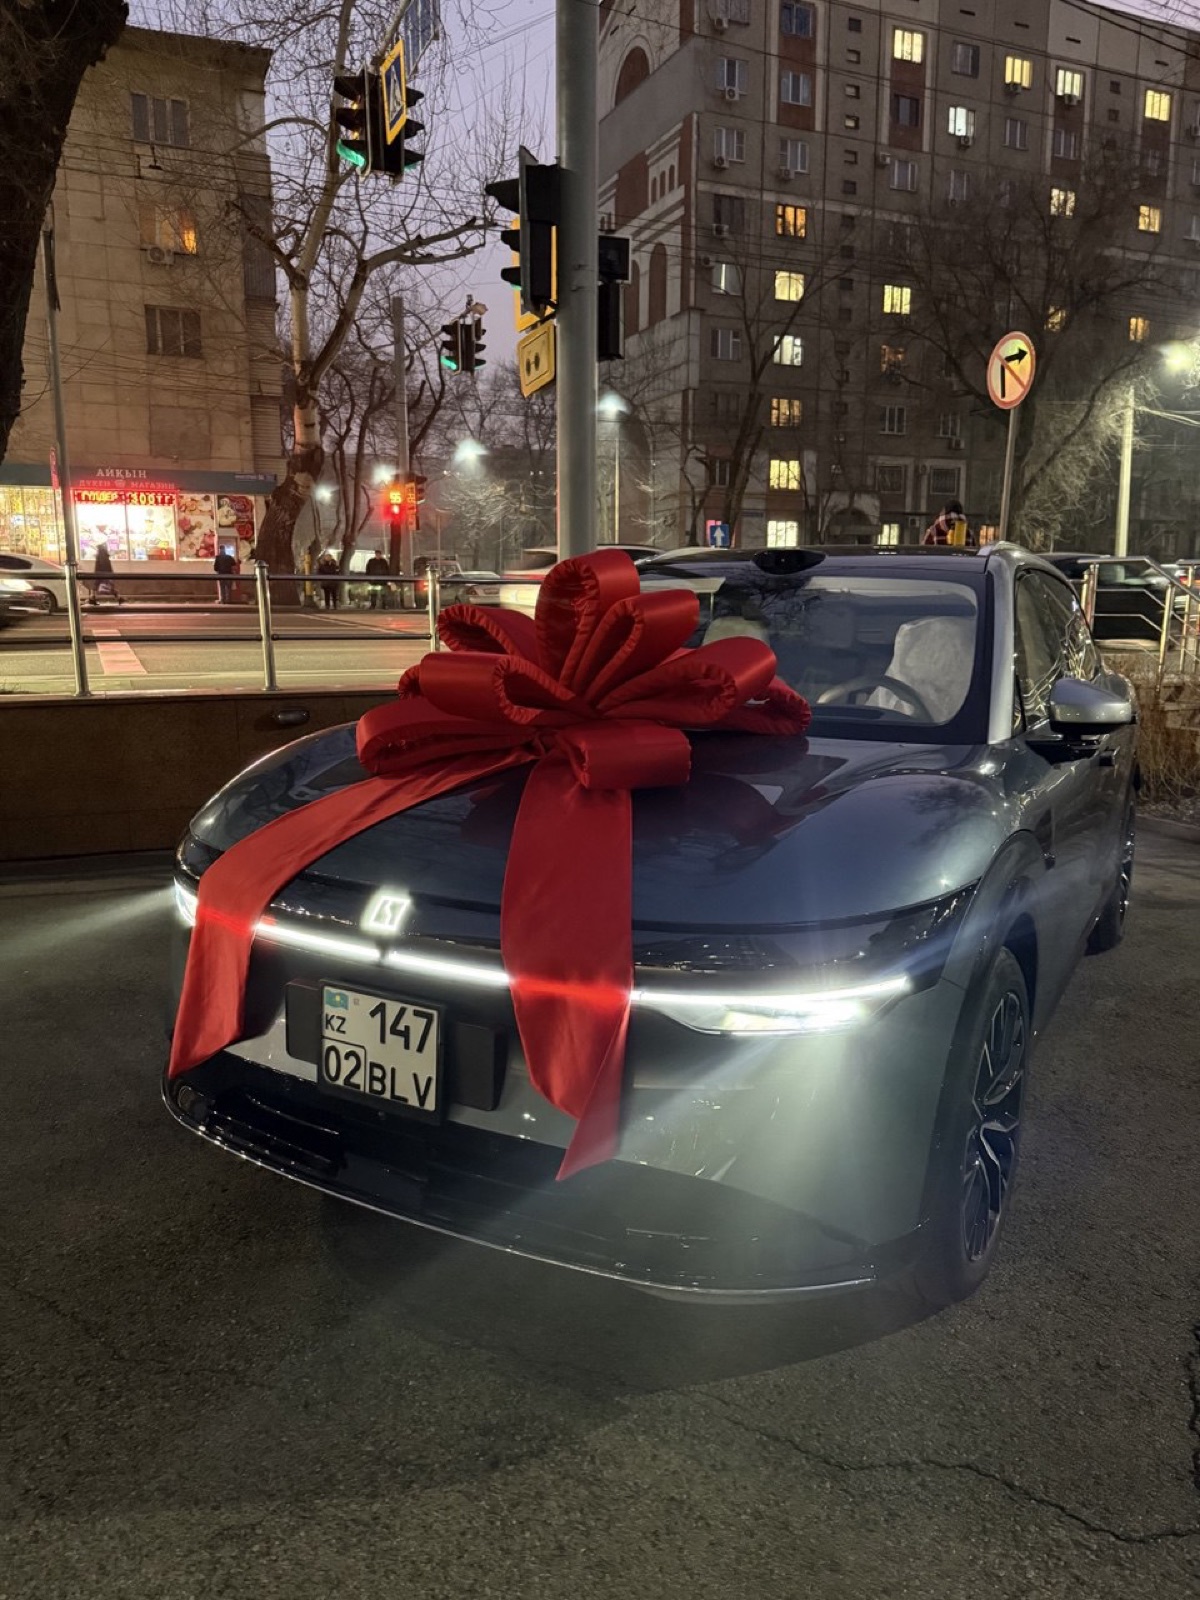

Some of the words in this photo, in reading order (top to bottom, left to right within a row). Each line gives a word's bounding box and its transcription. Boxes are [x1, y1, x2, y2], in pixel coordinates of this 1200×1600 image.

[96, 466, 147, 479] АЙҚЫН
[130, 481, 175, 489] МАГАЗИН
[325, 1013, 346, 1034] KZ
[369, 1001, 434, 1054] 147
[324, 1045, 361, 1090] 02
[368, 1062, 432, 1107] BLV
